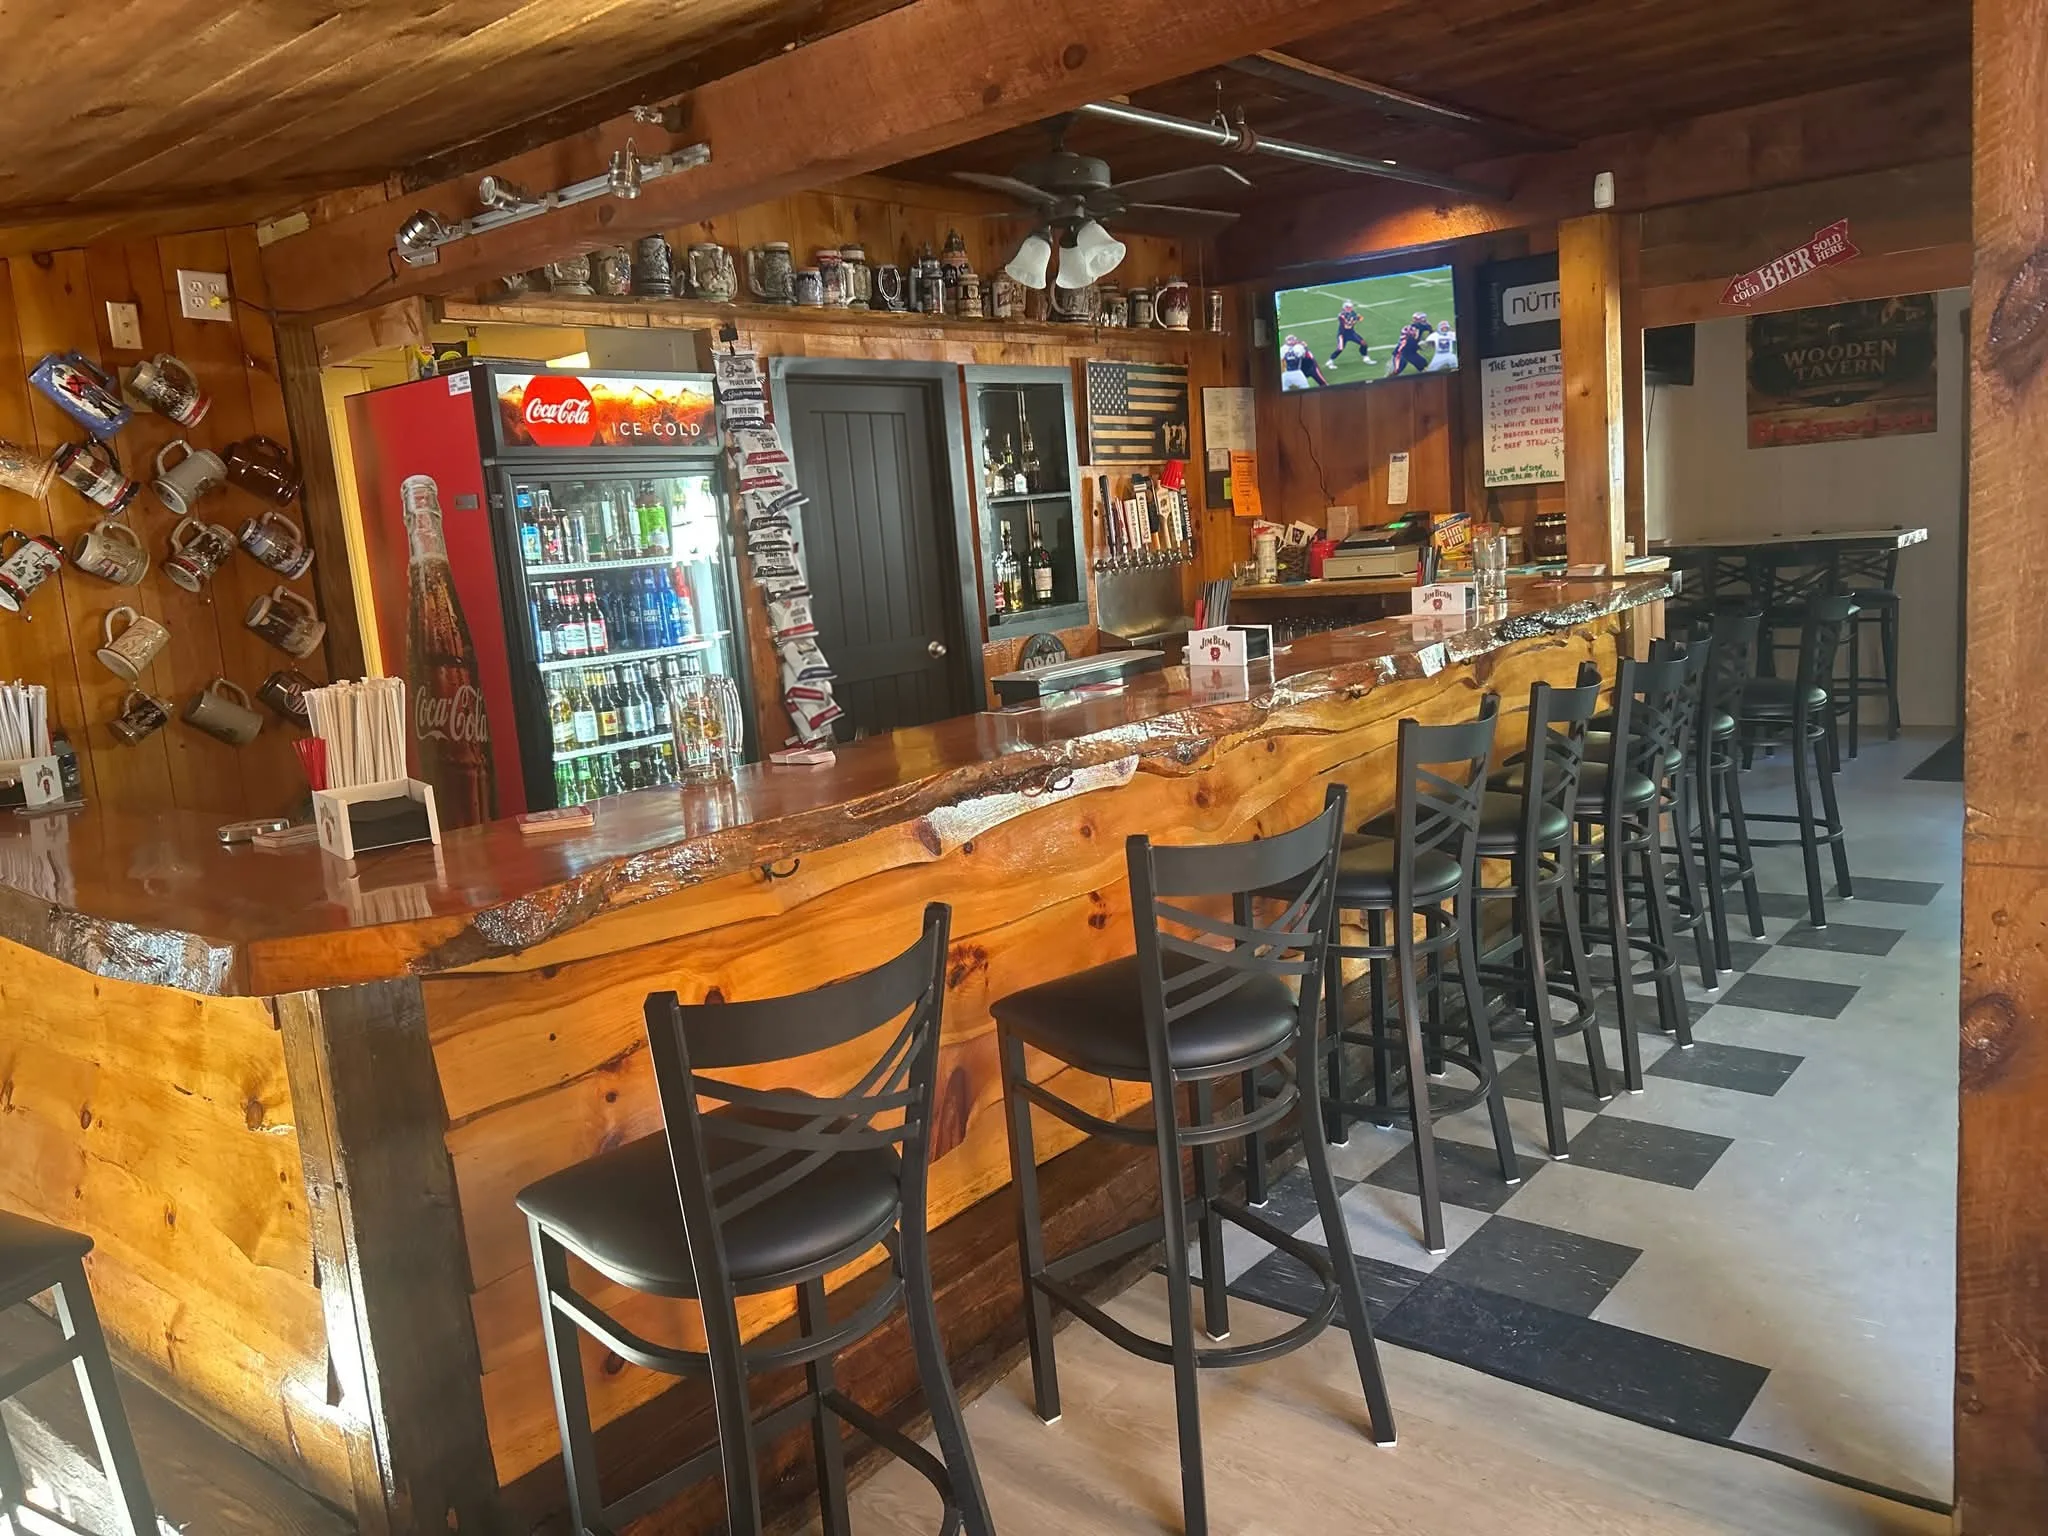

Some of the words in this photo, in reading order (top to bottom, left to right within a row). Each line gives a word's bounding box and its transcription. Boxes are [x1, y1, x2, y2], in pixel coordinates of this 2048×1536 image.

[1812, 233, 1841, 254] SOLD
[1815, 242, 1846, 262] HERE
[1757, 247, 1817, 292] BEER
[1732, 284, 1760, 303] COLD
[1734, 278, 1753, 293] ICE
[1782, 339, 1896, 370] WOODEN
[1488, 360, 1506, 372] THE
[1793, 358, 1885, 381] TAVERN
[525, 397, 592, 425] Coca-Cola
[612, 422, 643, 436] ICE
[653, 423, 701, 436] COLD
[1540, 470, 1559, 479] ROLL
[1182, 497, 1192, 537] DOWNEAST
[1423, 592, 1434, 603] JIM
[1435, 589, 1452, 600] BEAM
[1200, 637, 1212, 649] JIM
[1213, 635, 1231, 651] BEAM
[416, 685, 488, 742] Coca-Cola
